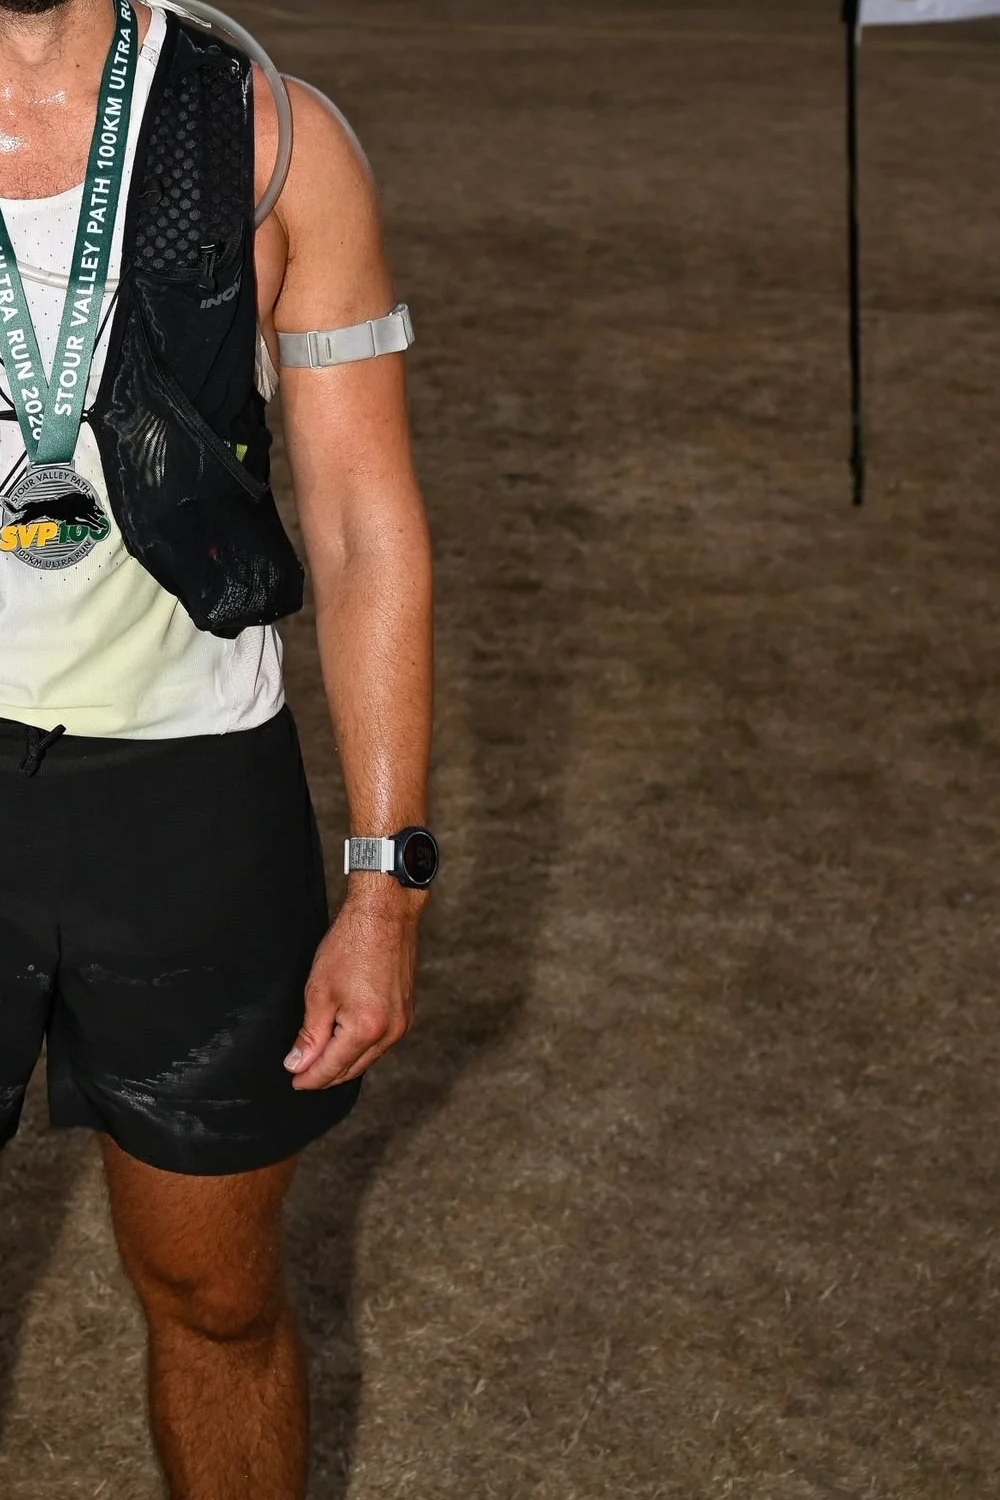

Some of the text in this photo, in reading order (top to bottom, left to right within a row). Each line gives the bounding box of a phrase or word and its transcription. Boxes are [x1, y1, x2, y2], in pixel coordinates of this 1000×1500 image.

[108, 28, 132, 91] ULTRA
[96, 96, 123, 170] 100KM
[86, 177, 111, 234] PATH
[70, 240, 102, 328] VALLEY
[7, 328, 36, 382] RUN
[54, 335, 85, 417] STOUR
[11, 471, 91, 504] STOUR VALLEY PATH
[16, 540, 93, 569] 100KM ULTRA RUN
